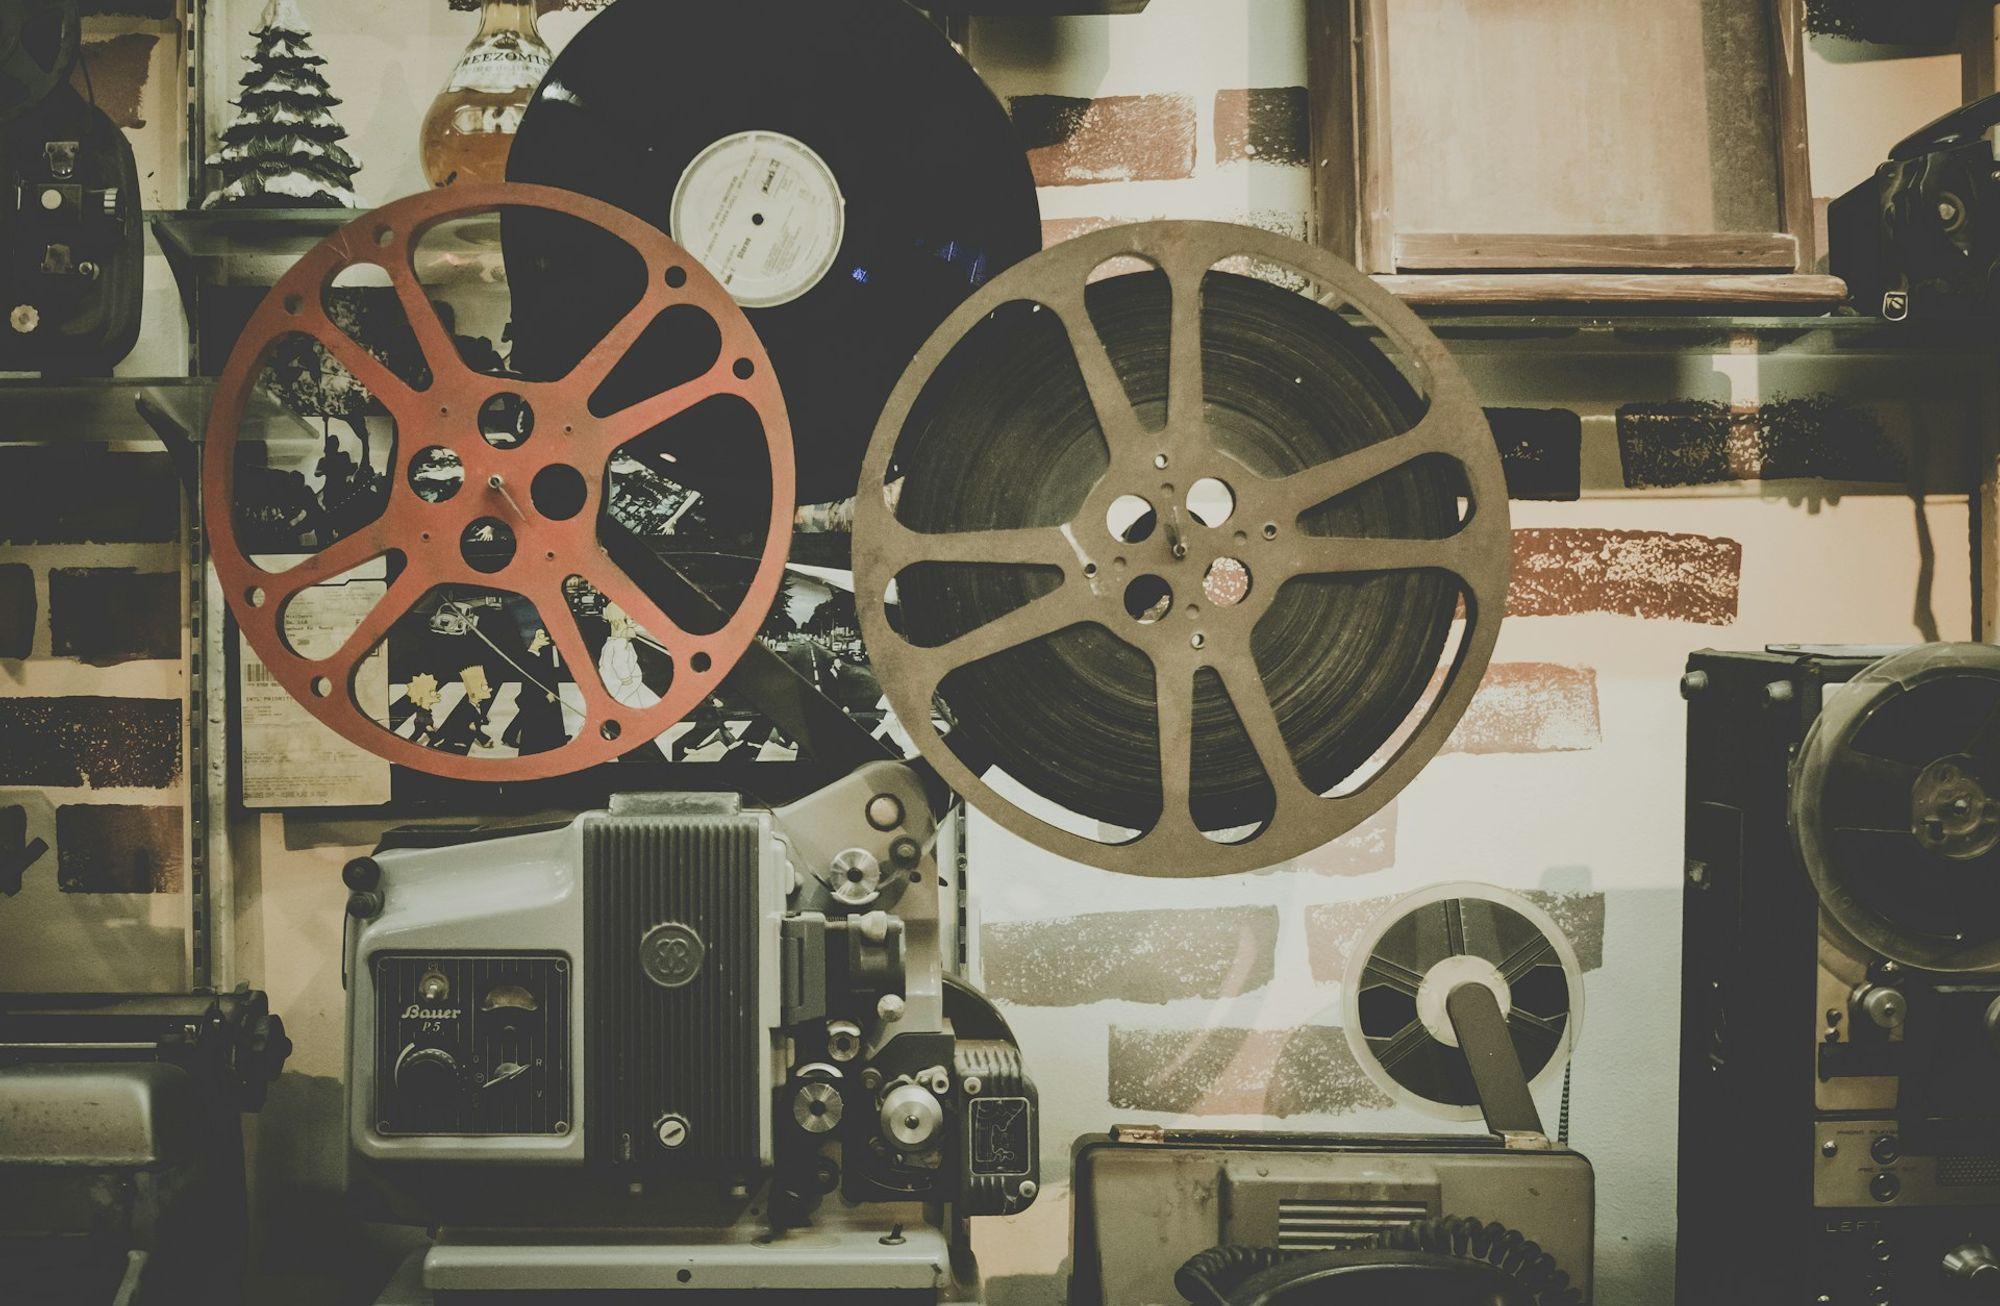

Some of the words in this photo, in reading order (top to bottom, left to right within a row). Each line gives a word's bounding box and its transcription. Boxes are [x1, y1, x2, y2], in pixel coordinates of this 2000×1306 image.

[401, 1004, 461, 1019] Bauer
[535, 1057, 543, 1067] R
[536, 1089, 543, 1099] V
[1826, 1221, 1880, 1232] LEFT
